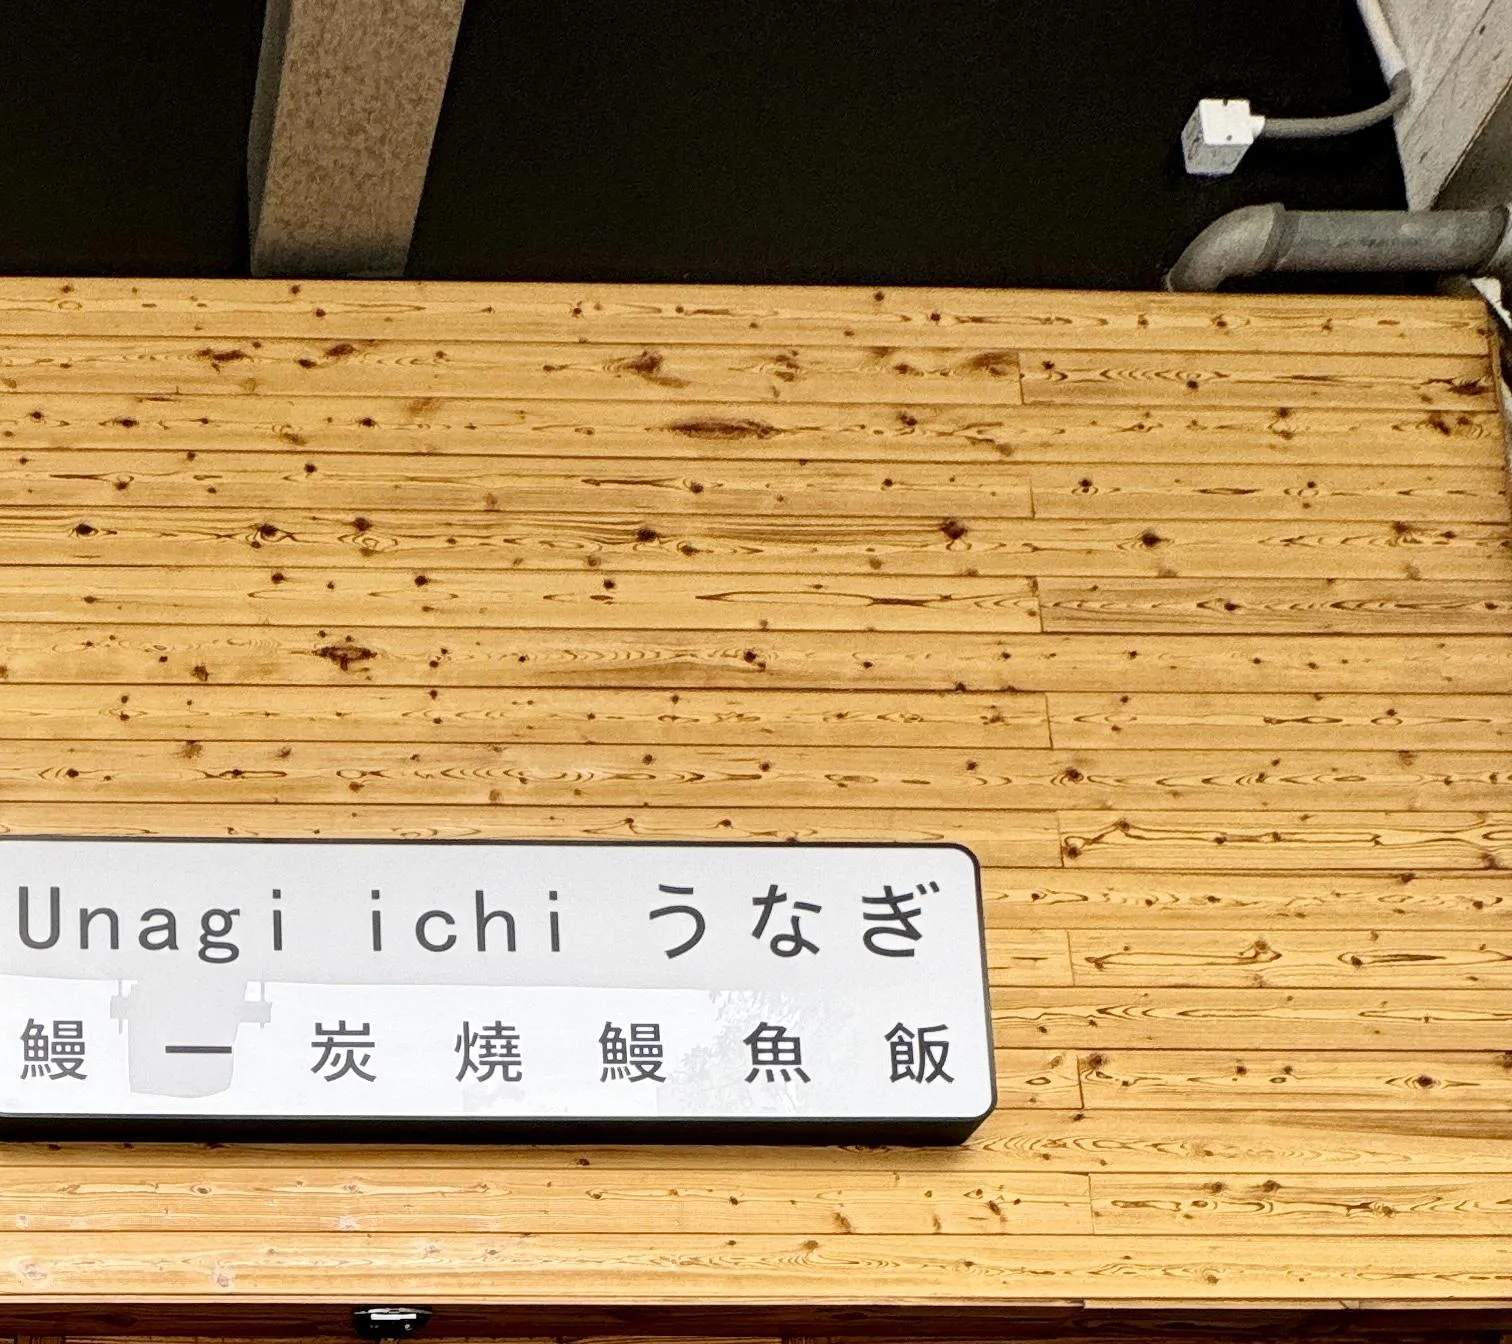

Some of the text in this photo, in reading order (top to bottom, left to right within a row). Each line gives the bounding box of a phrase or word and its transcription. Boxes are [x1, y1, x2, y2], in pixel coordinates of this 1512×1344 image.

[17, 880, 941, 963] Unagi ichi うなぎ
[19, 1017, 955, 1084] 鰻一炭燒鰻魚飯
